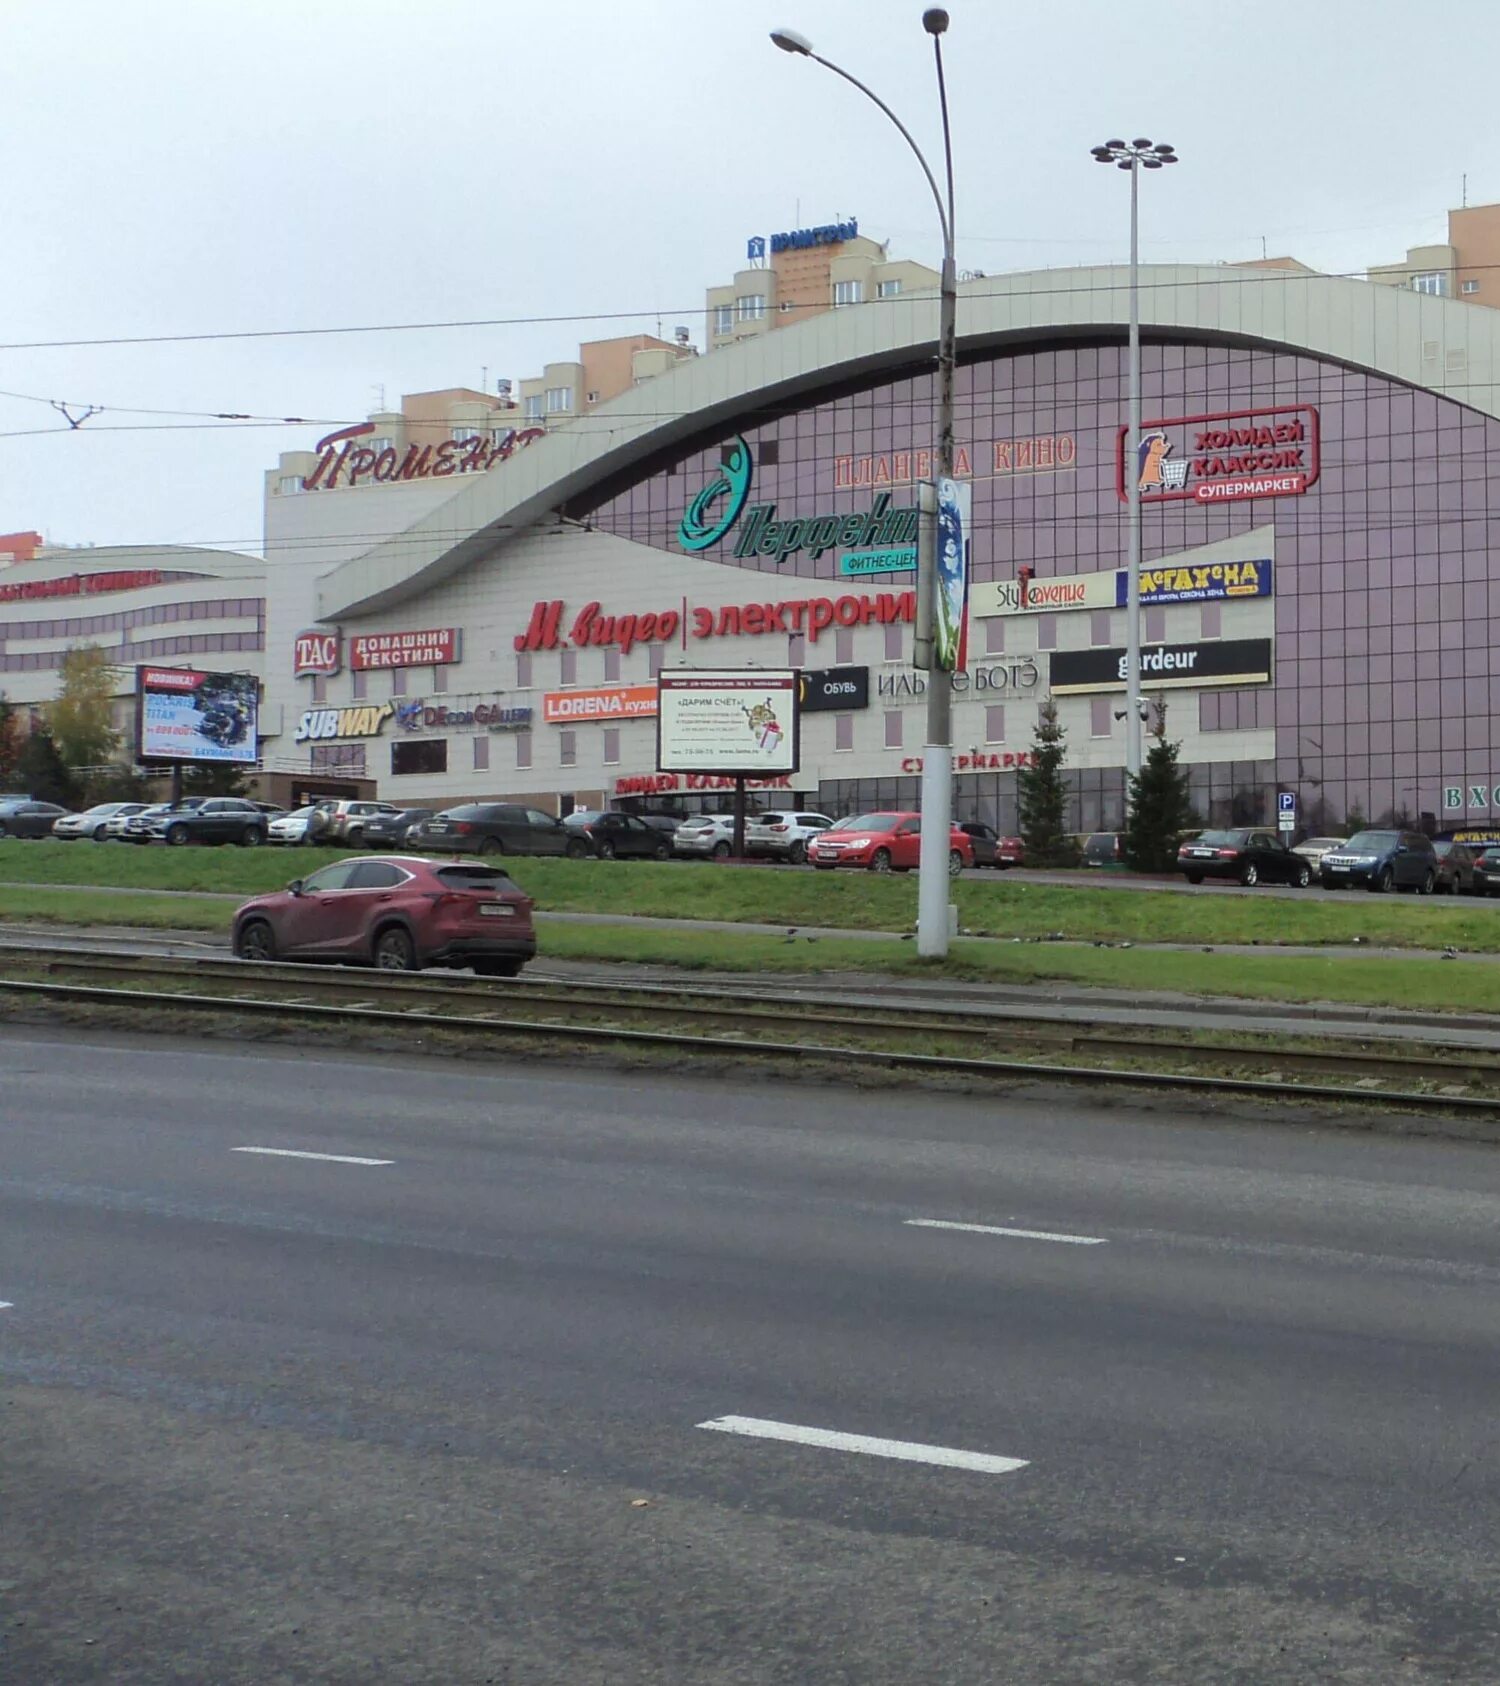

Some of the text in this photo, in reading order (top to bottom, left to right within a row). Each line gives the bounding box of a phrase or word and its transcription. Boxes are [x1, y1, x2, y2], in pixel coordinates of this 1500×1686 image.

[1194, 419, 1305, 451] ХОЛИДЕЙ
[834, 434, 1076, 489] ПЛАНЕА КИНО
[1193, 449, 1305, 476] КЛАССИК
[1198, 477, 1300, 498] СУПЕРМАРКЕТ
[356, 630, 450, 653] ДОМАШНИЙ
[362, 648, 444, 666] ТЕКСТИЛЬ
[1117, 647, 1198, 680] grdeur
[823, 682, 857, 695] ОБУВЬ
[878, 672, 925, 696] ИЛЬ
[547, 695, 623, 717] LORENA
[294, 702, 394, 742] SUBWAY
